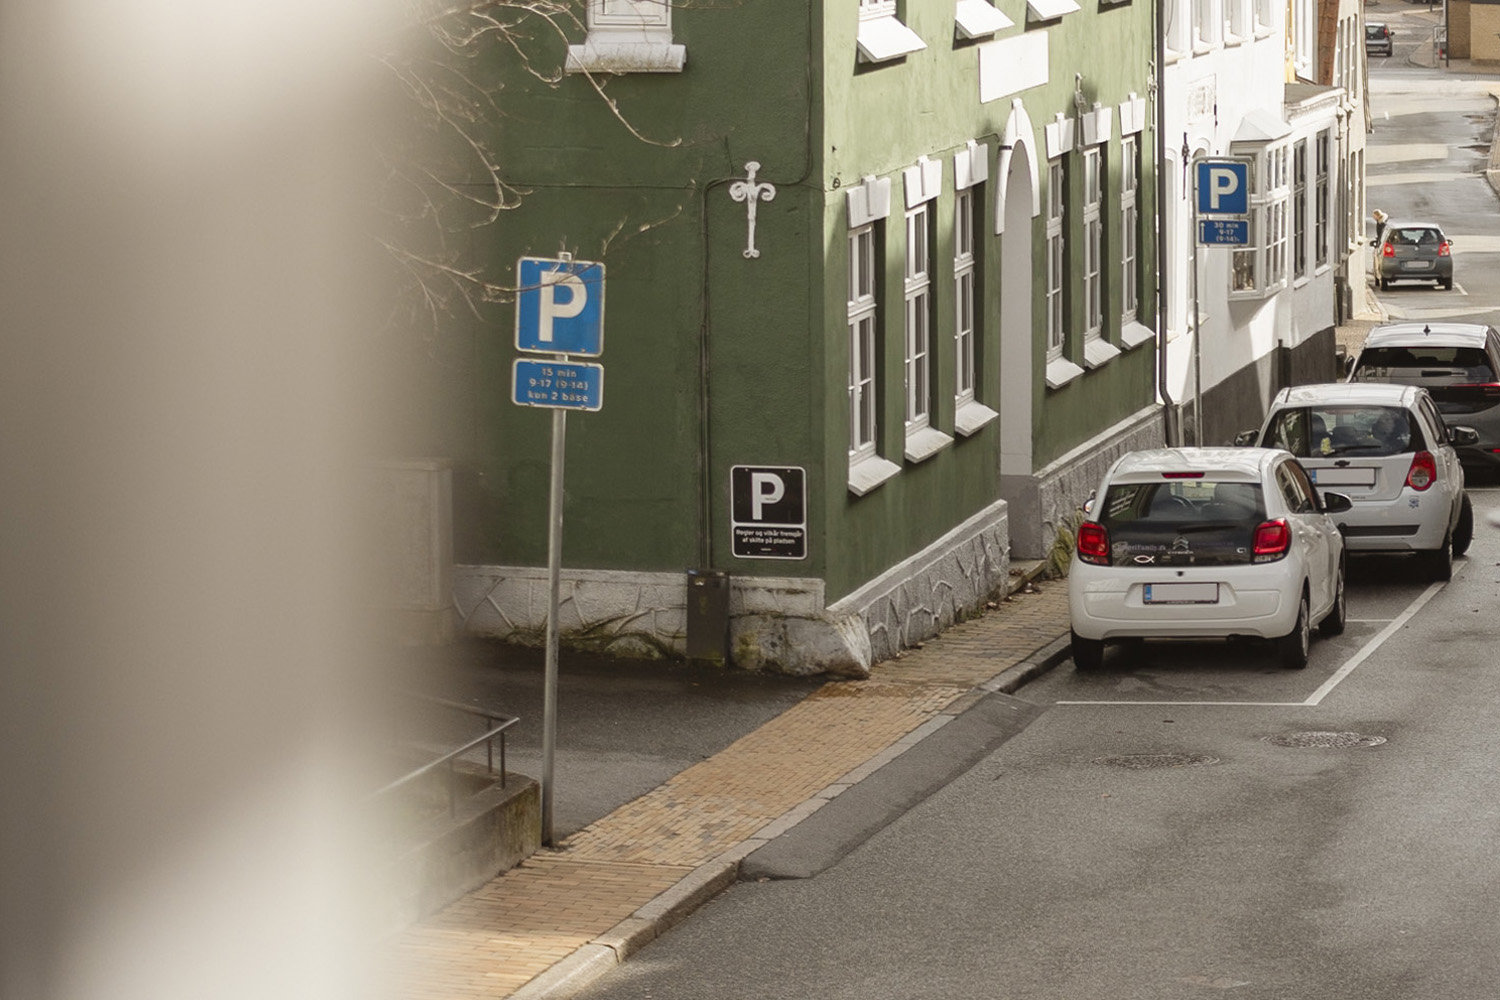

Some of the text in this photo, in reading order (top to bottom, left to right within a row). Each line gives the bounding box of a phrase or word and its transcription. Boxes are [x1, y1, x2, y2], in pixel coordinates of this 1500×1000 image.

[1210, 168, 1239, 209] P
[539, 271, 587, 342] P
[529, 378, 552, 387] 9-17
[542, 368, 577, 377] 15 min
[528, 391, 548, 399] kun
[551, 392, 558, 400] 2
[752, 472, 785, 520] P
